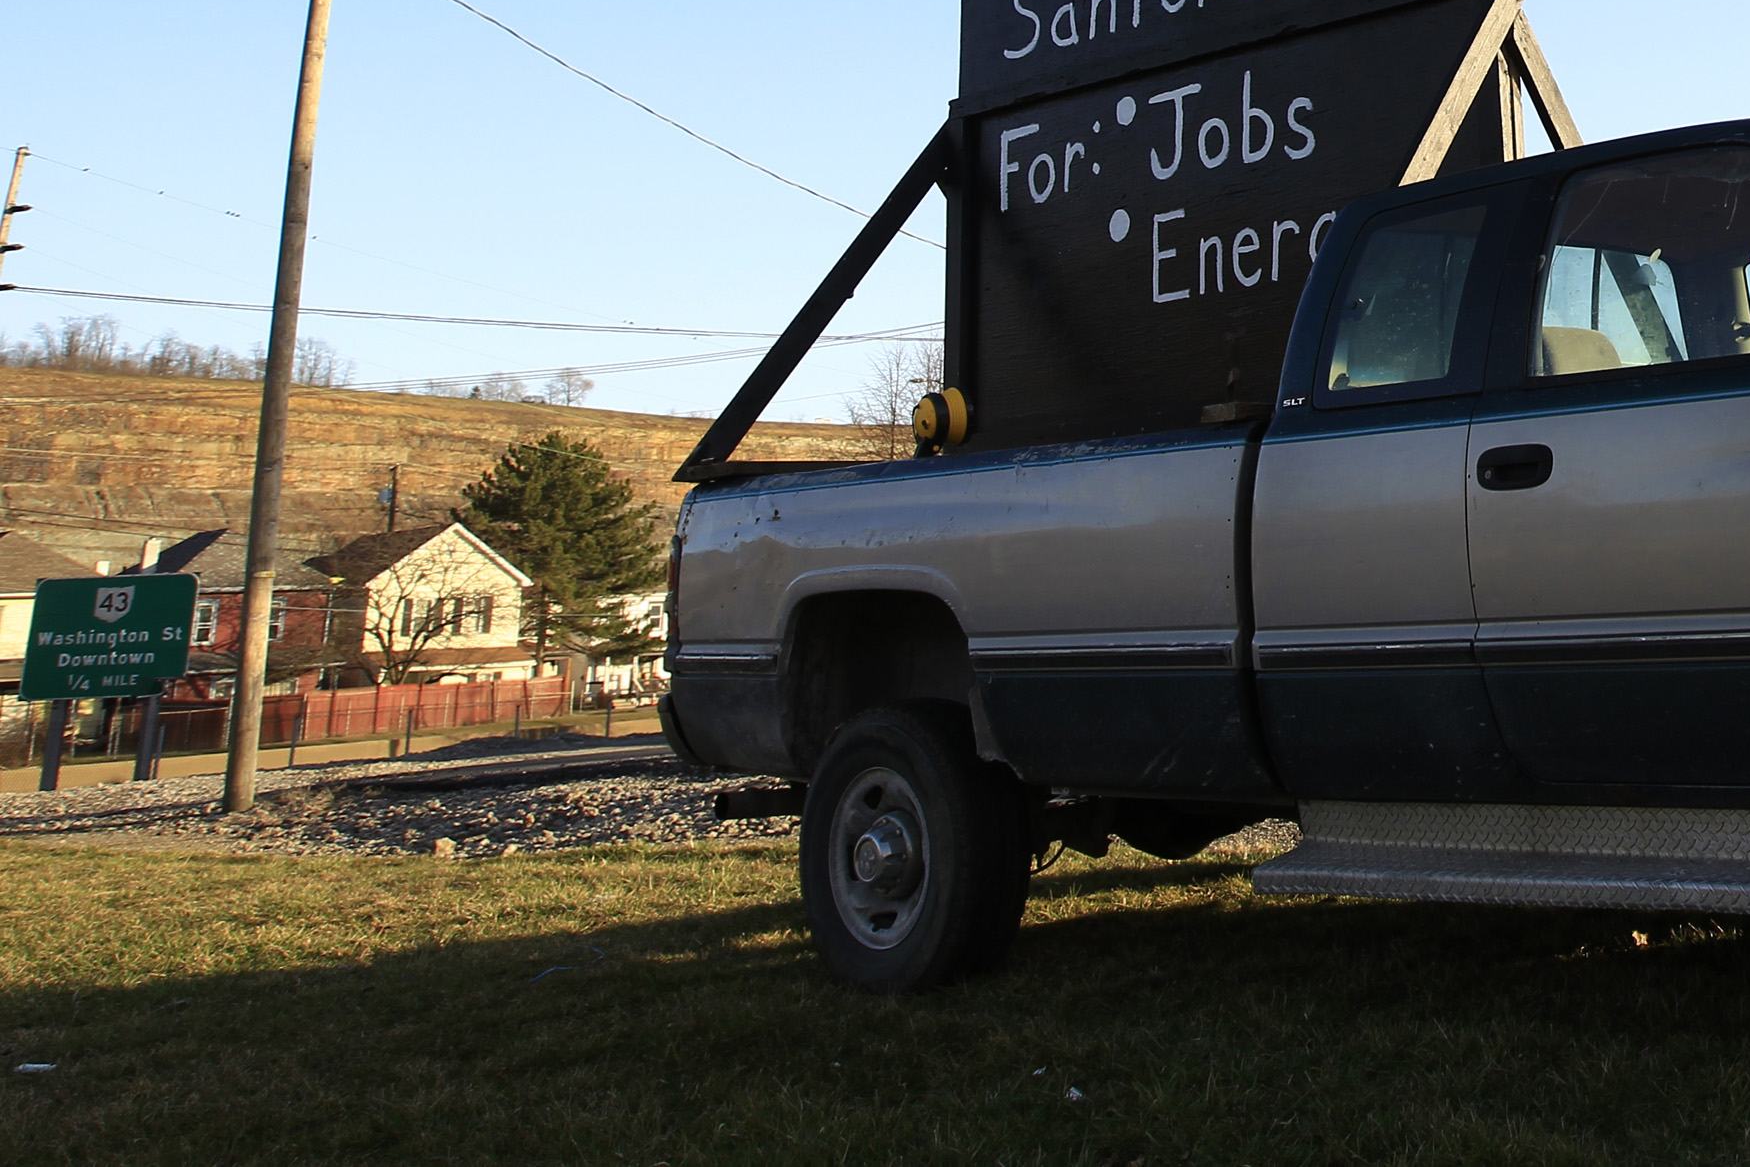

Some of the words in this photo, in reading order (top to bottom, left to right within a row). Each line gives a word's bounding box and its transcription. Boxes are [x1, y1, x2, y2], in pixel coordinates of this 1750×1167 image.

[1000, 120, 1101, 213] For:
[1148, 70, 1316, 181] Jobs
[1283, 397, 1305, 407] SLT
[98, 591, 130, 613] 43
[38, 628, 150, 649] Washington
[162, 626, 183, 642] St
[58, 651, 156, 668] Downtown
[102, 674, 140, 687] MILE
